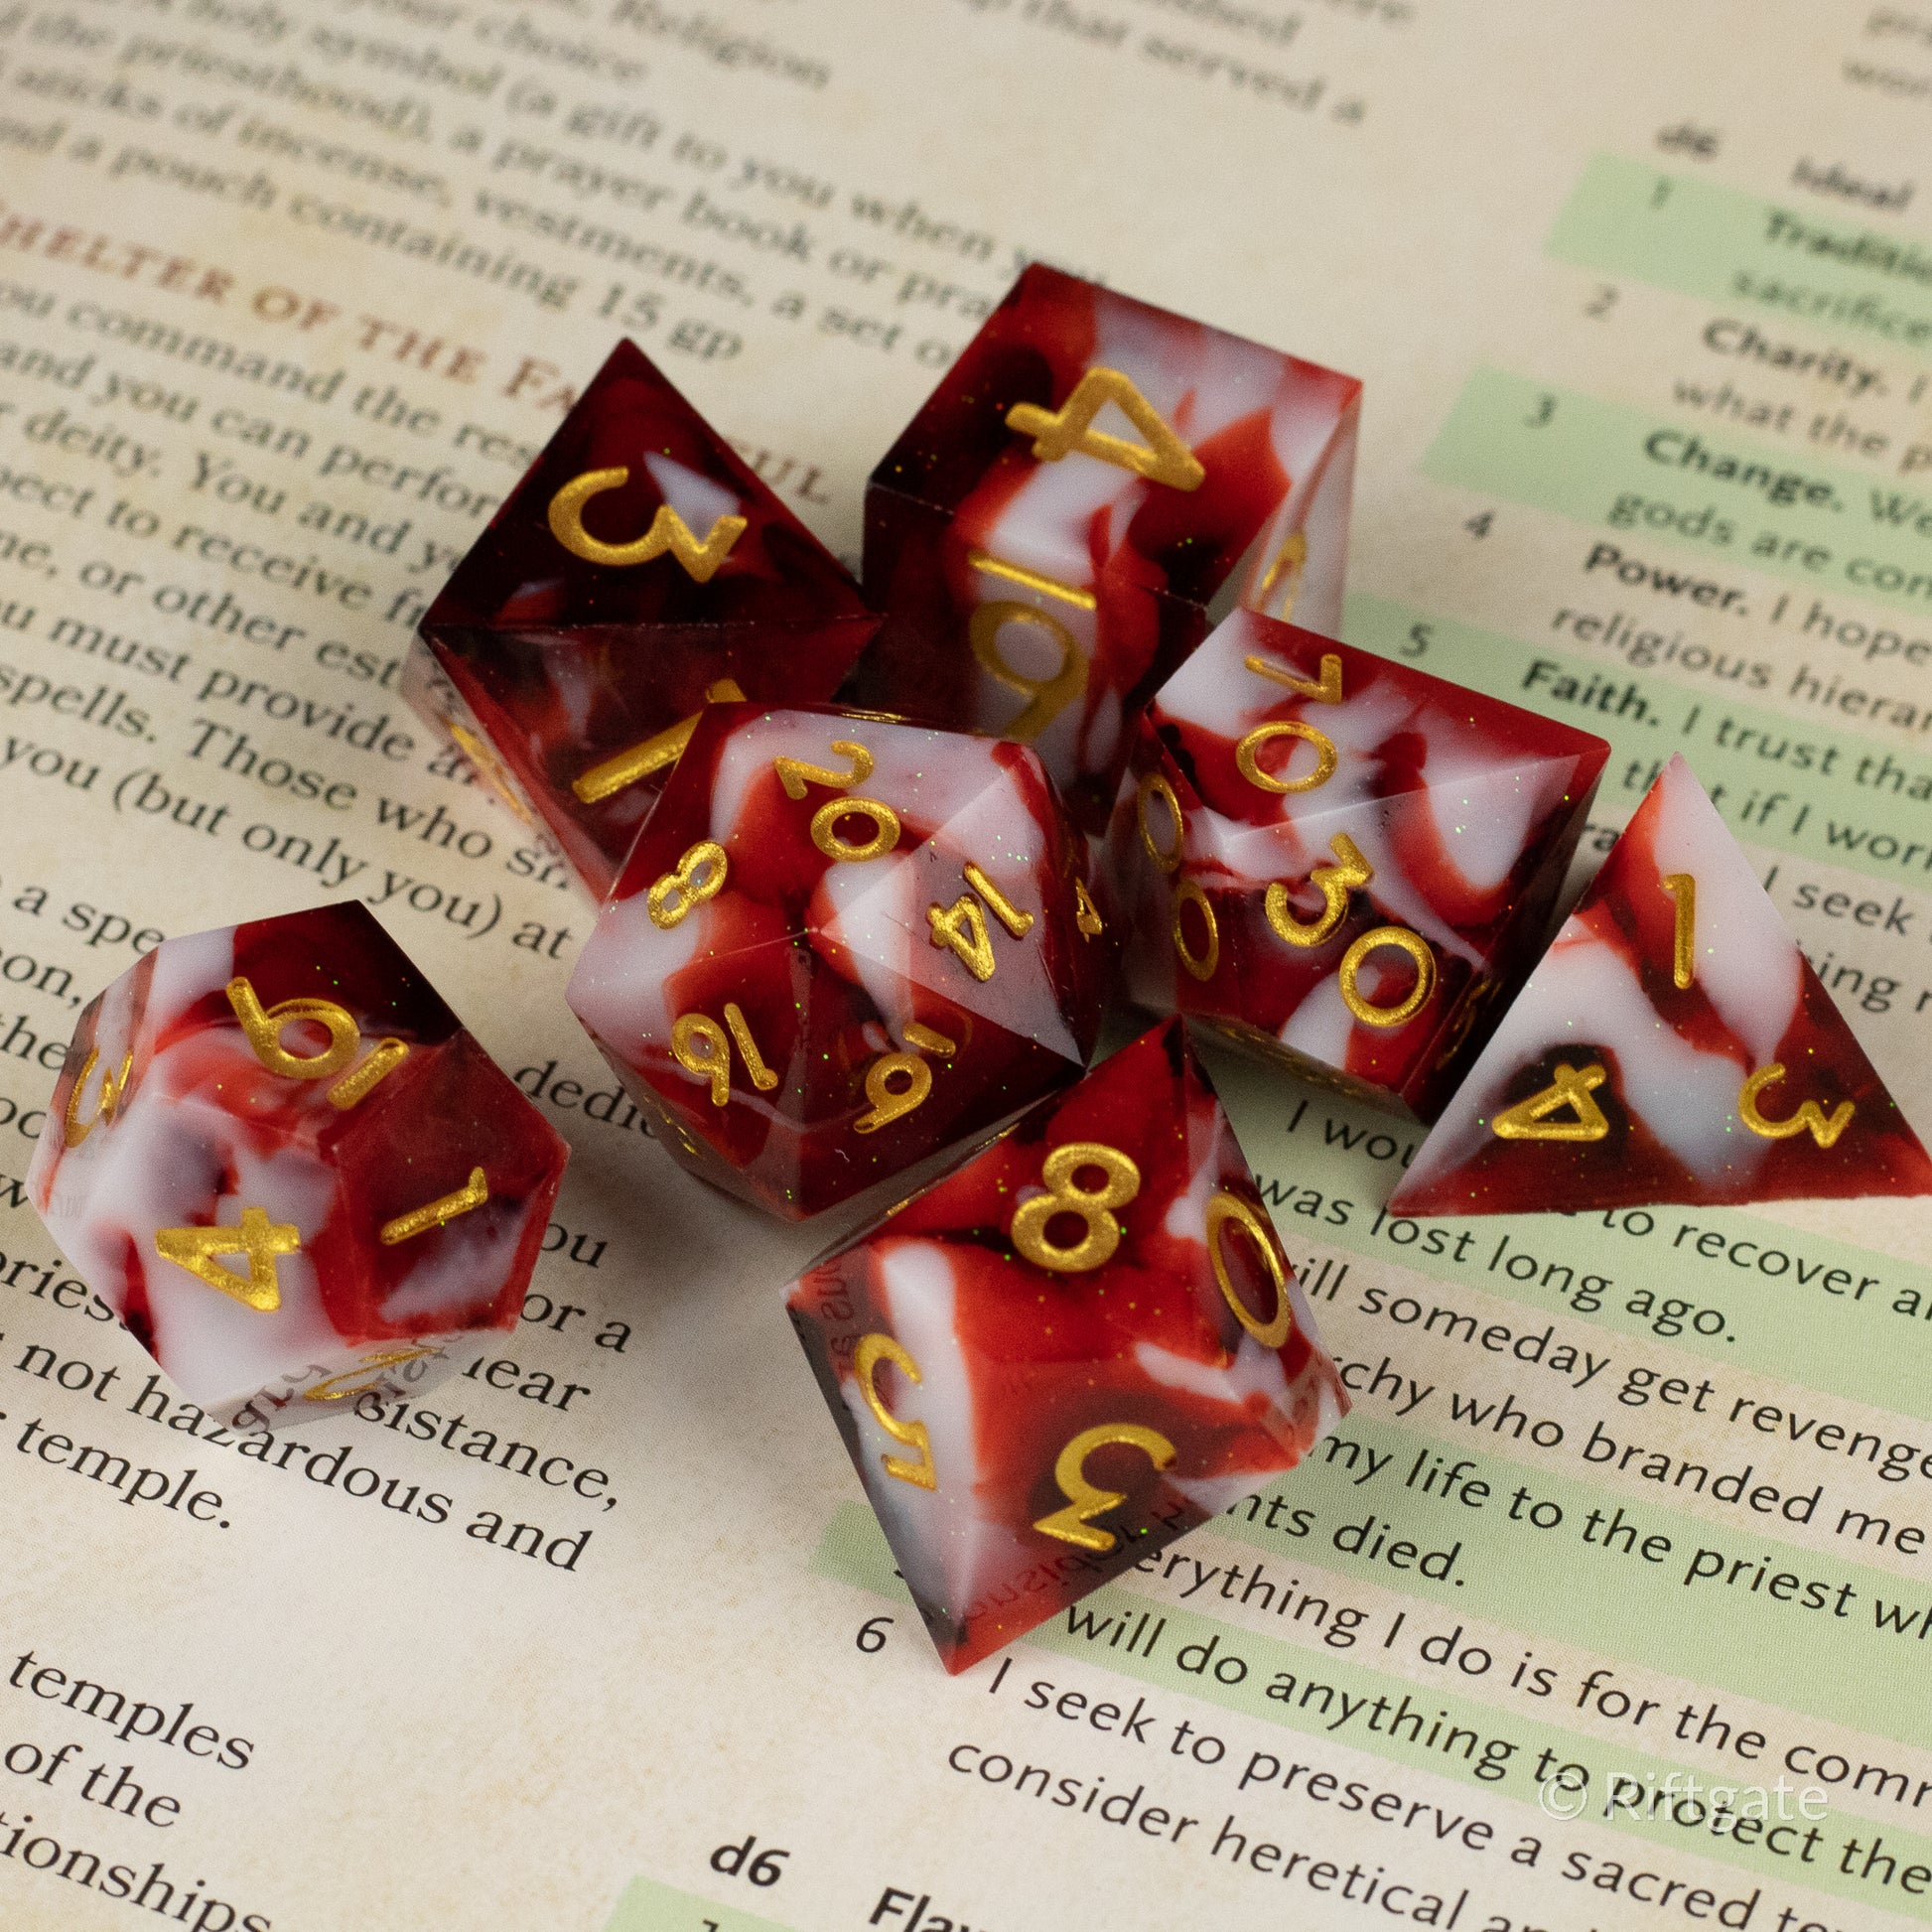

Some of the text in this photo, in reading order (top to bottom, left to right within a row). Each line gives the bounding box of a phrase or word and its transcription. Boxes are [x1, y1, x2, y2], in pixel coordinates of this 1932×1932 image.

[0, 211, 488, 387] HELTER OF THE
[894, 271, 996, 323] pra
[67, 297, 441, 437] command the
[91, 370, 503, 520] you can perfor
[1005, 367, 1205, 491] 4
[1525, 393, 1558, 430] 3
[1644, 427, 1847, 514] Change.
[105, 498, 162, 539] to
[171, 524, 373, 612] receive
[191, 450, 288, 516] You
[297, 500, 413, 556] and
[548, 467, 749, 584] 3
[1606, 490, 1832, 573] gods are
[77, 559, 400, 689] or other est
[1464, 509, 1932, 675] 4 Power. I hope
[1551, 607, 1775, 693] religious
[47, 616, 417, 764] must provide
[1401, 624, 1840, 777] 5 Faith. I trust
[188, 717, 358, 814] Those
[374, 793, 495, 860] who
[774, 739, 901, 863] 20
[1740, 788, 1790, 827] if
[1791, 801, 1810, 837] I
[11, 883, 49, 917] a
[112, 766, 234, 838] (but
[240, 822, 368, 892] only
[365, 868, 506, 939] you)
[510, 917, 576, 961] at
[647, 840, 729, 930] 8
[924, 861, 1035, 982] 14
[1791, 883, 1916, 938] seek
[1264, 833, 1438, 1029] 30
[1662, 873, 1697, 990] 1
[1286, 1099, 1310, 1133] I
[1491, 1063, 1610, 1142] 4
[1738, 1063, 1856, 1147] 3
[155, 1206, 301, 1312] 4
[380, 1166, 488, 1246] 1
[1011, 1142, 1141, 1273] 8
[1252, 1173, 1736, 1343] was lost long ago.
[1672, 1220, 1881, 1303] recover
[1205, 1193, 1292, 1349] 0
[593, 1322, 635, 1353] a
[1357, 1285, 1716, 1408] someday get
[14, 1342, 123, 1408] not
[125, 1373, 456, 1525] hazardous
[466, 1509, 597, 1573] and
[17, 1414, 232, 1530] temple.
[854, 1333, 938, 1491] 5
[1449, 1390, 1927, 1556] who branded me
[1034, 1422, 1177, 1552] 3
[1404, 1448, 1492, 1510] life
[1506, 1486, 1566, 1532] to
[1581, 1506, 1674, 1566] the
[1684, 1547, 1860, 1620] priest
[1331, 1515, 1468, 1590] died.
[8, 1649, 255, 1771] temples
[1135, 1542, 1371, 1651] erything
[1383, 1610, 1407, 1651] I
[1419, 1624, 1494, 1678] do
[1509, 1651, 1560, 1700] is
[1576, 1669, 1662, 1728] for
[1674, 1702, 1768, 1761] the
[3, 1742, 182, 1828] of the
[856, 1614, 896, 1655] 6
[988, 1656, 1014, 1697] I
[1023, 1678, 1157, 1745] seek
[1169, 1719, 1228, 1765] to
[1238, 1749, 1495, 1853] preserve
[1509, 1835, 1543, 1869] a
[1561, 1850, 1763, 1932] sacred
[1064, 1603, 1932, 1894] will do anything to protect the
[709, 1834, 792, 1888] d6
[947, 1742, 1471, 1932] consider heretical
